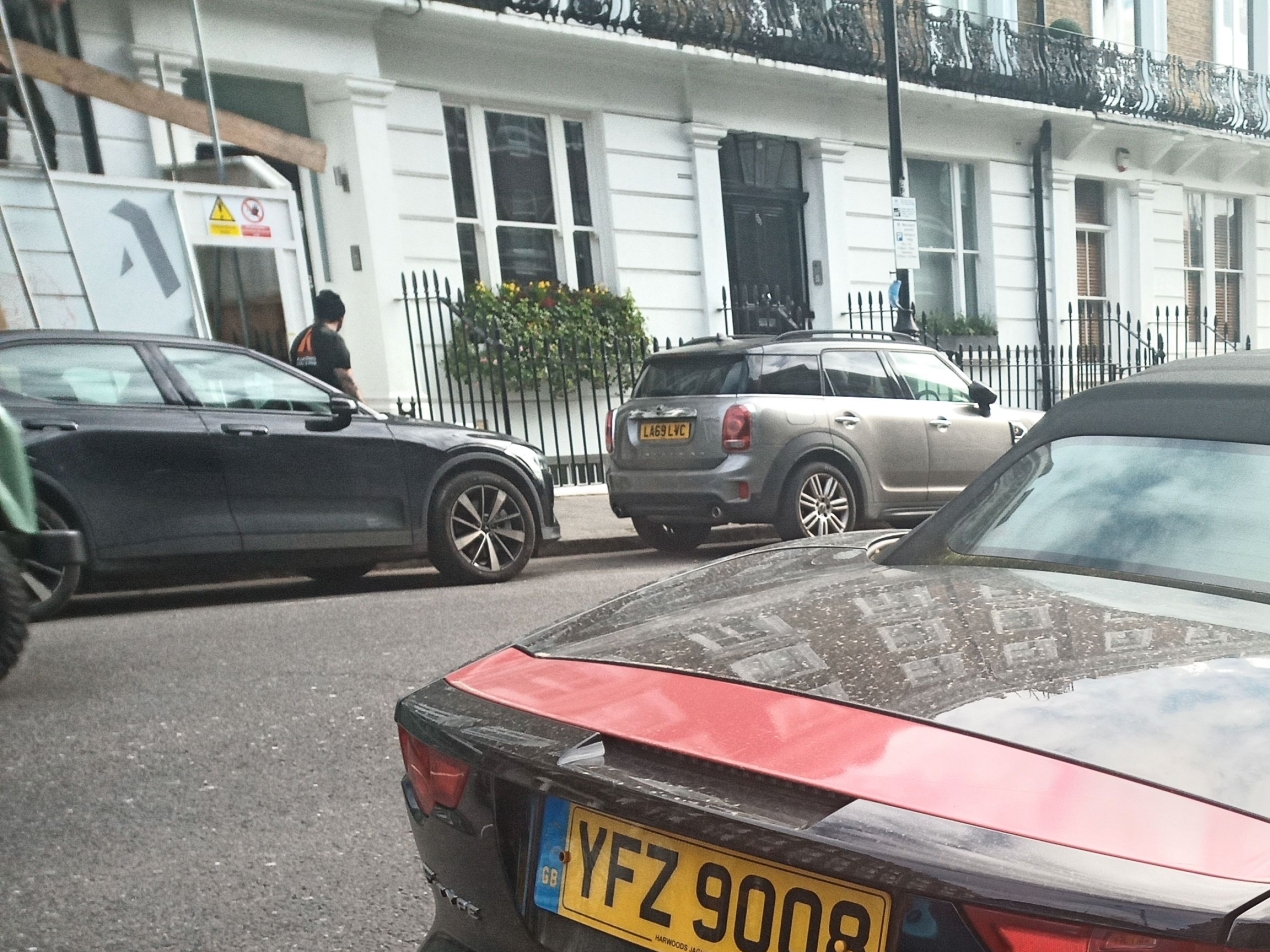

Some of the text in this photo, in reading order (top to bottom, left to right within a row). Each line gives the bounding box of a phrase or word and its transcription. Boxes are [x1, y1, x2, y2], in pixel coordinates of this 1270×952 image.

[643, 423, 667, 438] LA69
[541, 865, 558, 888] GB
[579, 820, 679, 929] YFZ
[655, 934, 688, 952] HARWOODS
